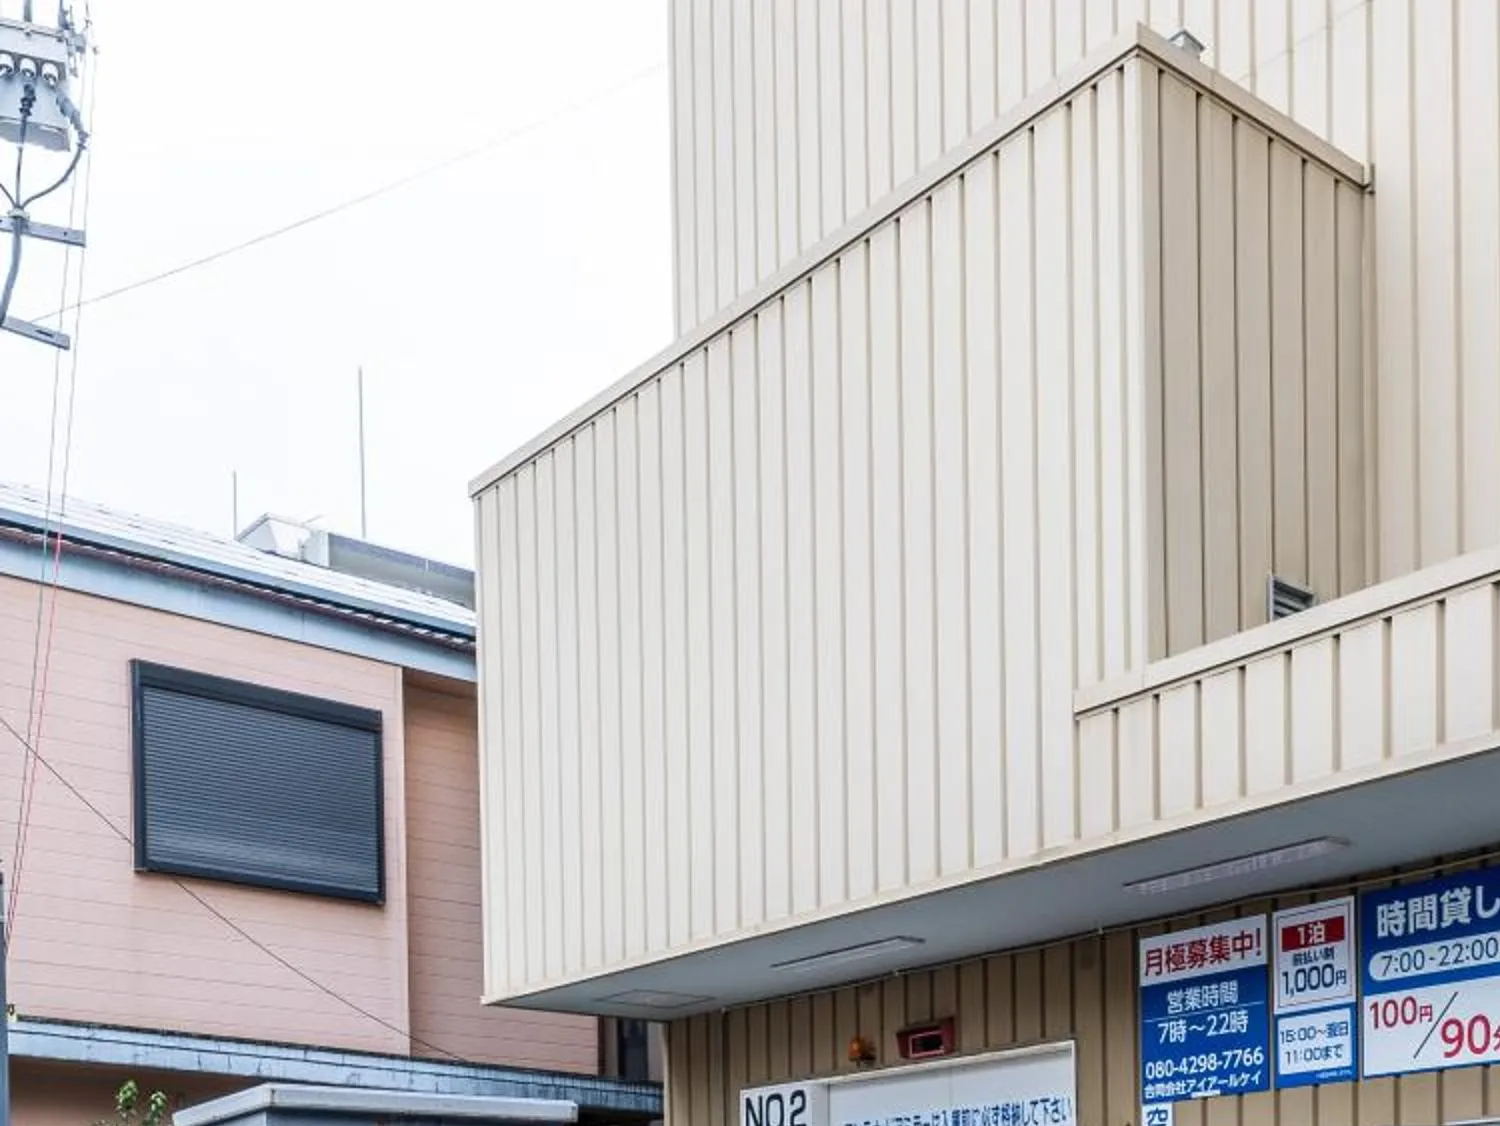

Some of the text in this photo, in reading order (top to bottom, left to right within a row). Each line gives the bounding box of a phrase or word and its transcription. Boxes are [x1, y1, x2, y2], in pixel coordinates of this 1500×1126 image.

[1297, 921, 1326, 945] 1泊
[1145, 927, 1261, 977] 月極募集中!
[1167, 980, 1239, 1014] 営業時間
[1282, 963, 1347, 997] 1,000円
[1368, 995, 1434, 1030] 100円
[1145, 1045, 1265, 1079] 080-4298-7766
